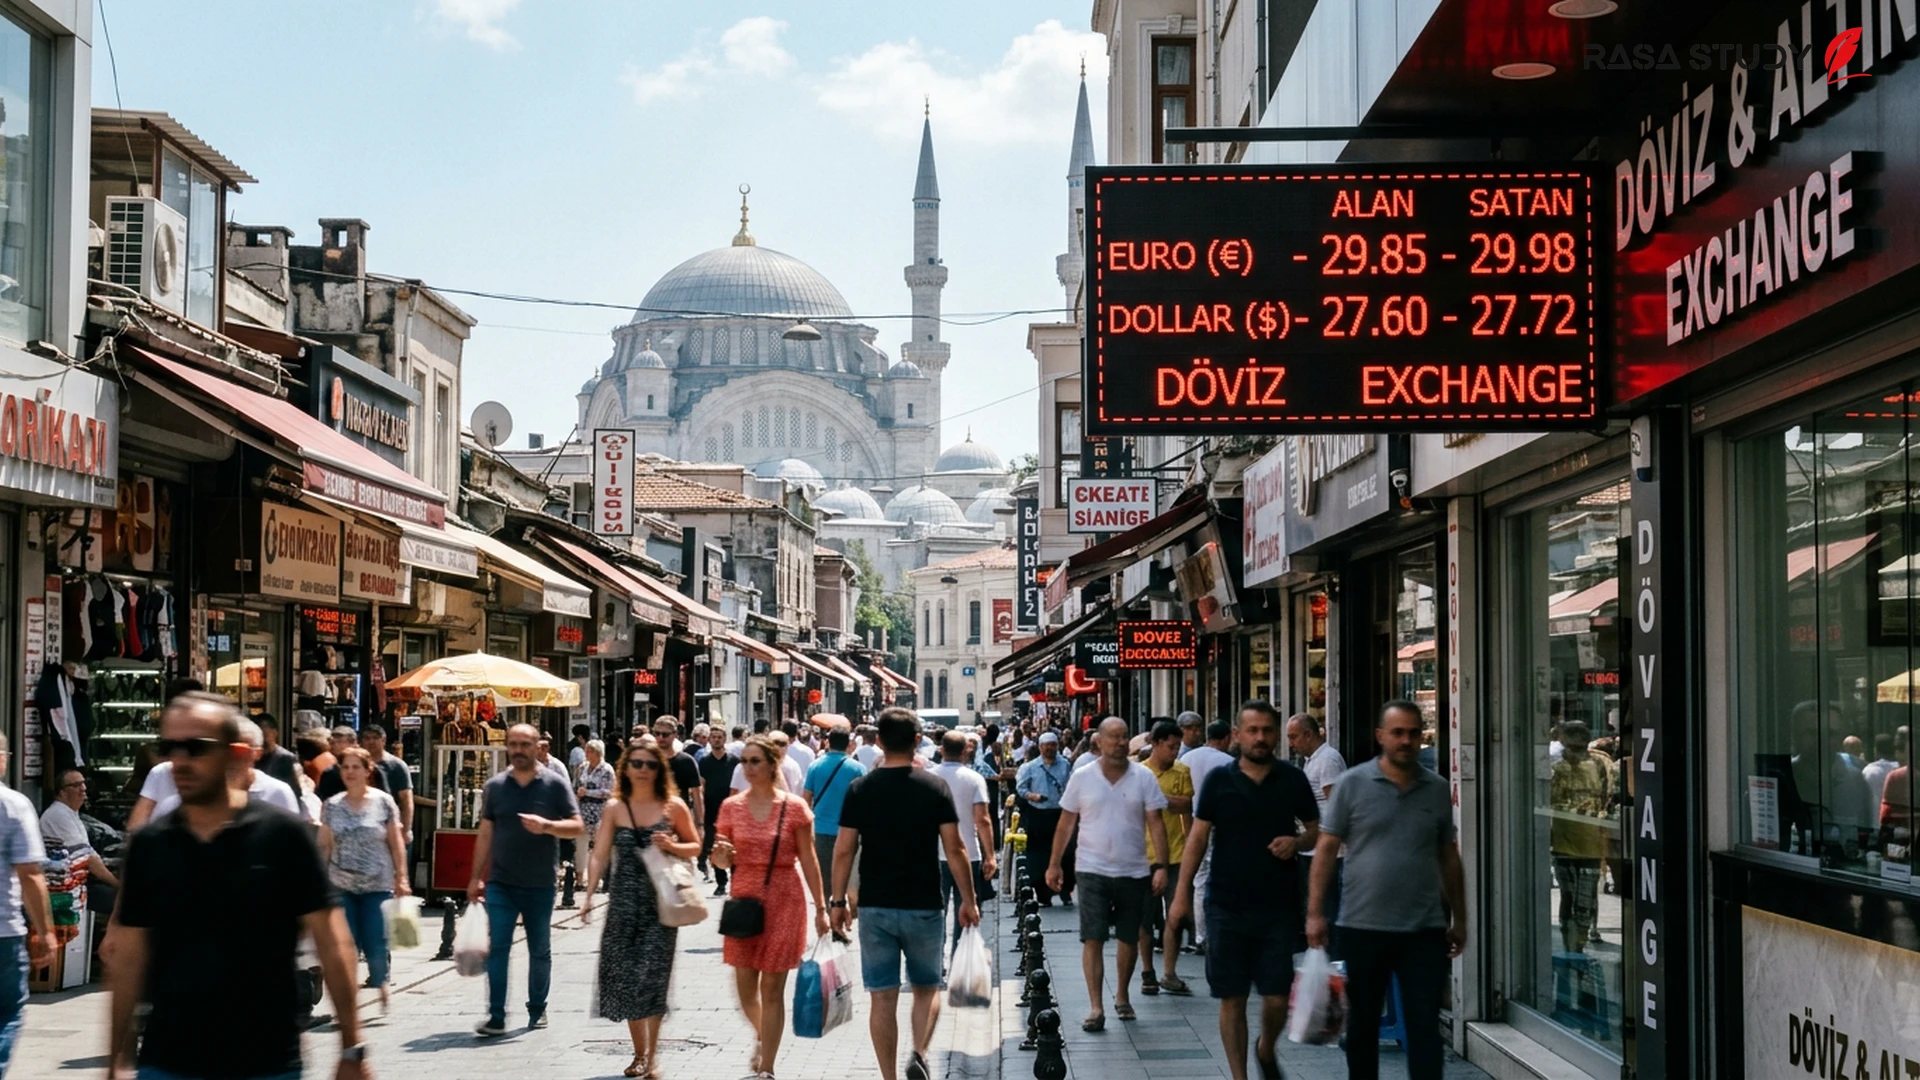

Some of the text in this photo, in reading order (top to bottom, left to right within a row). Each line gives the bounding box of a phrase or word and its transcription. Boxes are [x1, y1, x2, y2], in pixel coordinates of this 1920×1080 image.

[1616, 81, 1716, 252] DÖVİZ
[1727, 58, 1757, 168] &
[1331, 188, 1573, 218] ALAN SATAN
[1109, 241, 1196, 271] EURO
[1207, 238, 1254, 277] (€)
[1322, 233, 1427, 275] 29.85
[1470, 232, 1576, 274] 29.98
[1665, 151, 1855, 347] EXCHANGE
[1109, 304, 1235, 334] DOLLAR
[1322, 295, 1428, 337] 27.60
[1471, 294, 1577, 336] 27.72
[1157, 357, 1583, 406] DÖVİZ EXCHANGE
[1788, 1006, 1849, 1080] DÖVİZ
[1855, 1039, 1870, 1080] &
